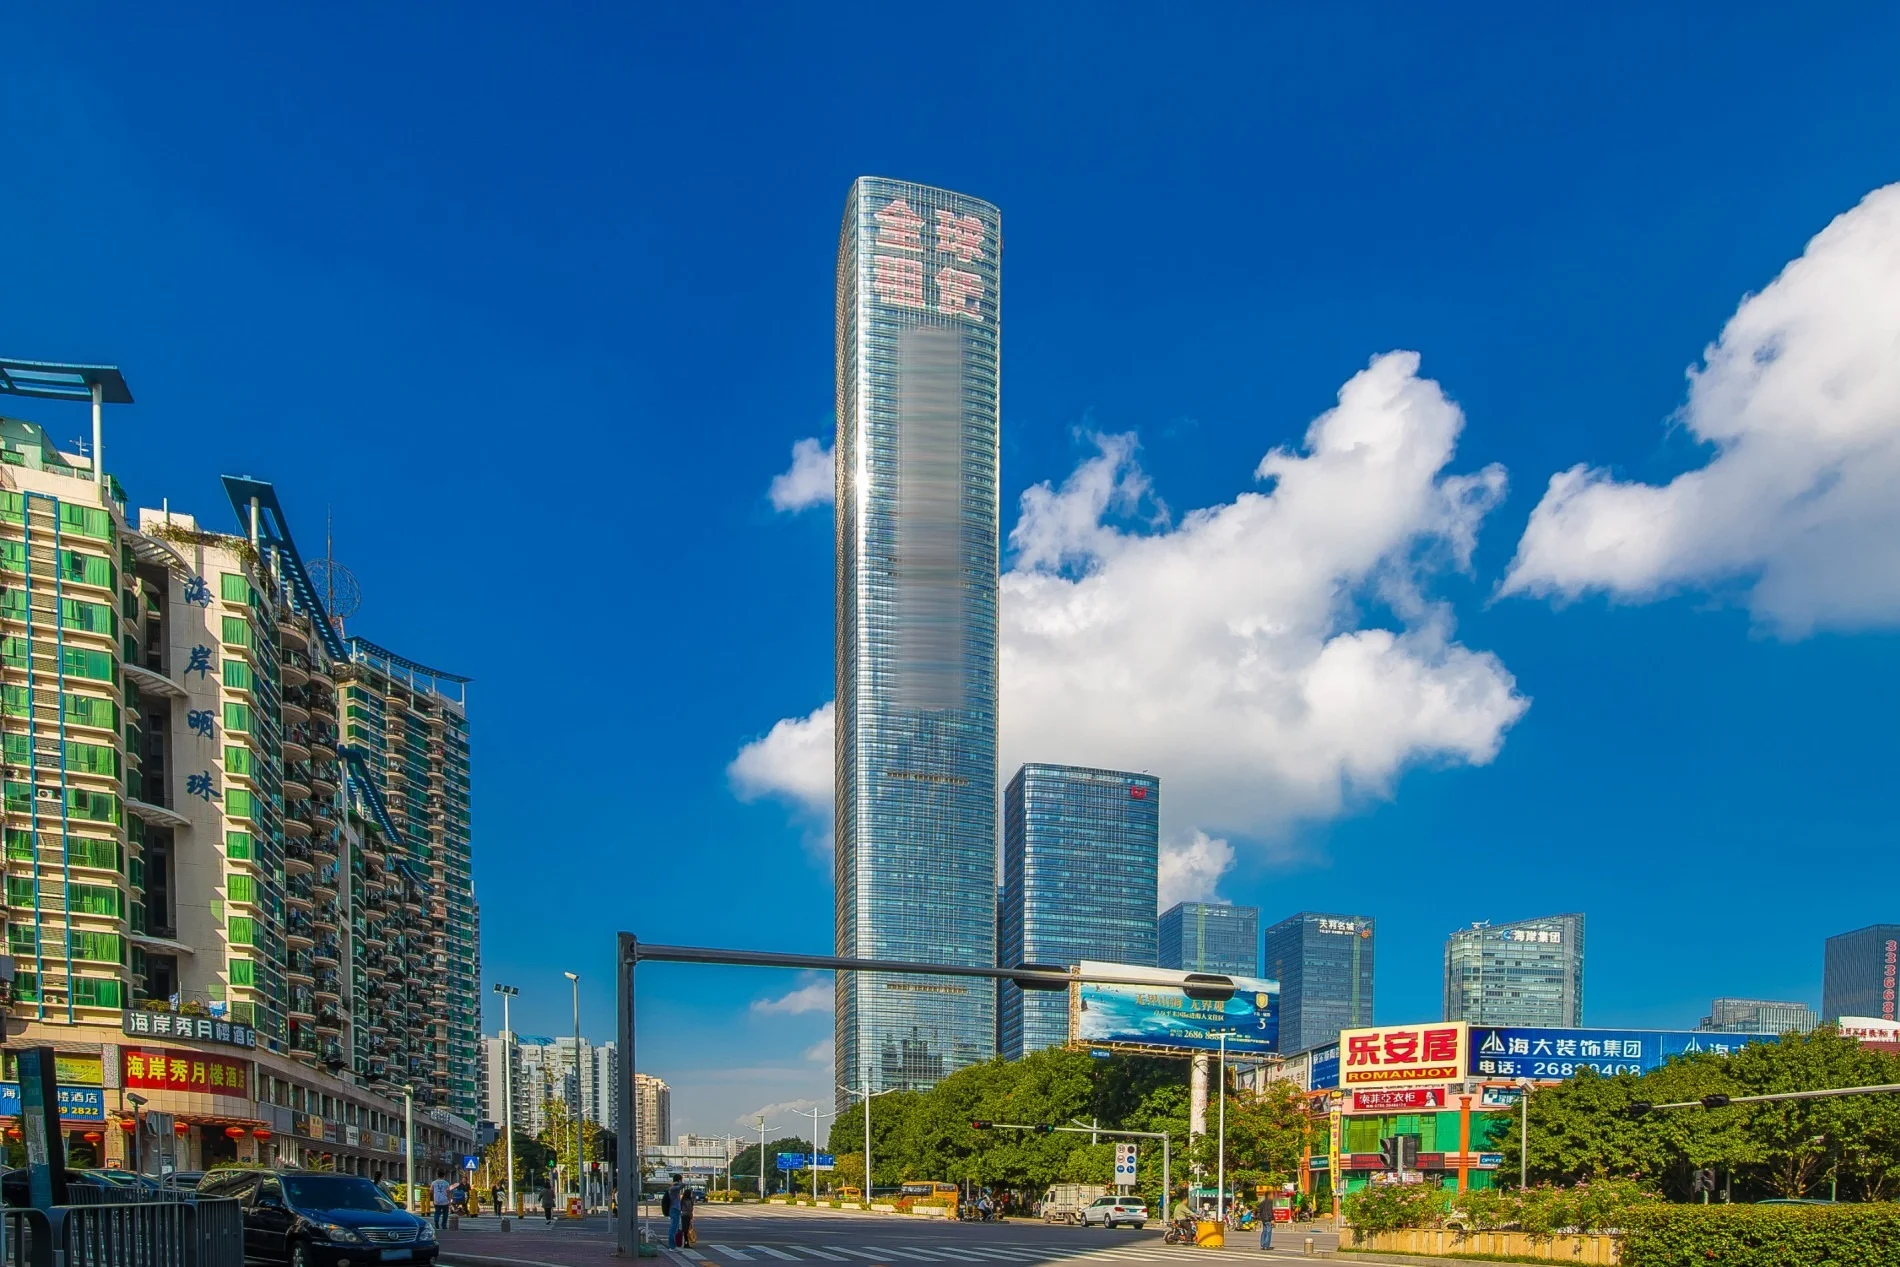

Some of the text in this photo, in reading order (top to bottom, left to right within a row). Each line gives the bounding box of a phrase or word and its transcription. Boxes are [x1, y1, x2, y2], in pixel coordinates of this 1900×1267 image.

[184, 575, 222, 802] 海岸明珠
[130, 1012, 256, 1047] 海岸秀月楼酒店
[1347, 1028, 1458, 1066] 乐安居
[1508, 1037, 1642, 1058] 海大装饰集团
[127, 1055, 245, 1089] 海岸秀月楼酒店
[1348, 1067, 1454, 1081] ROMANJOY
[71, 1107, 99, 1115] 2822
